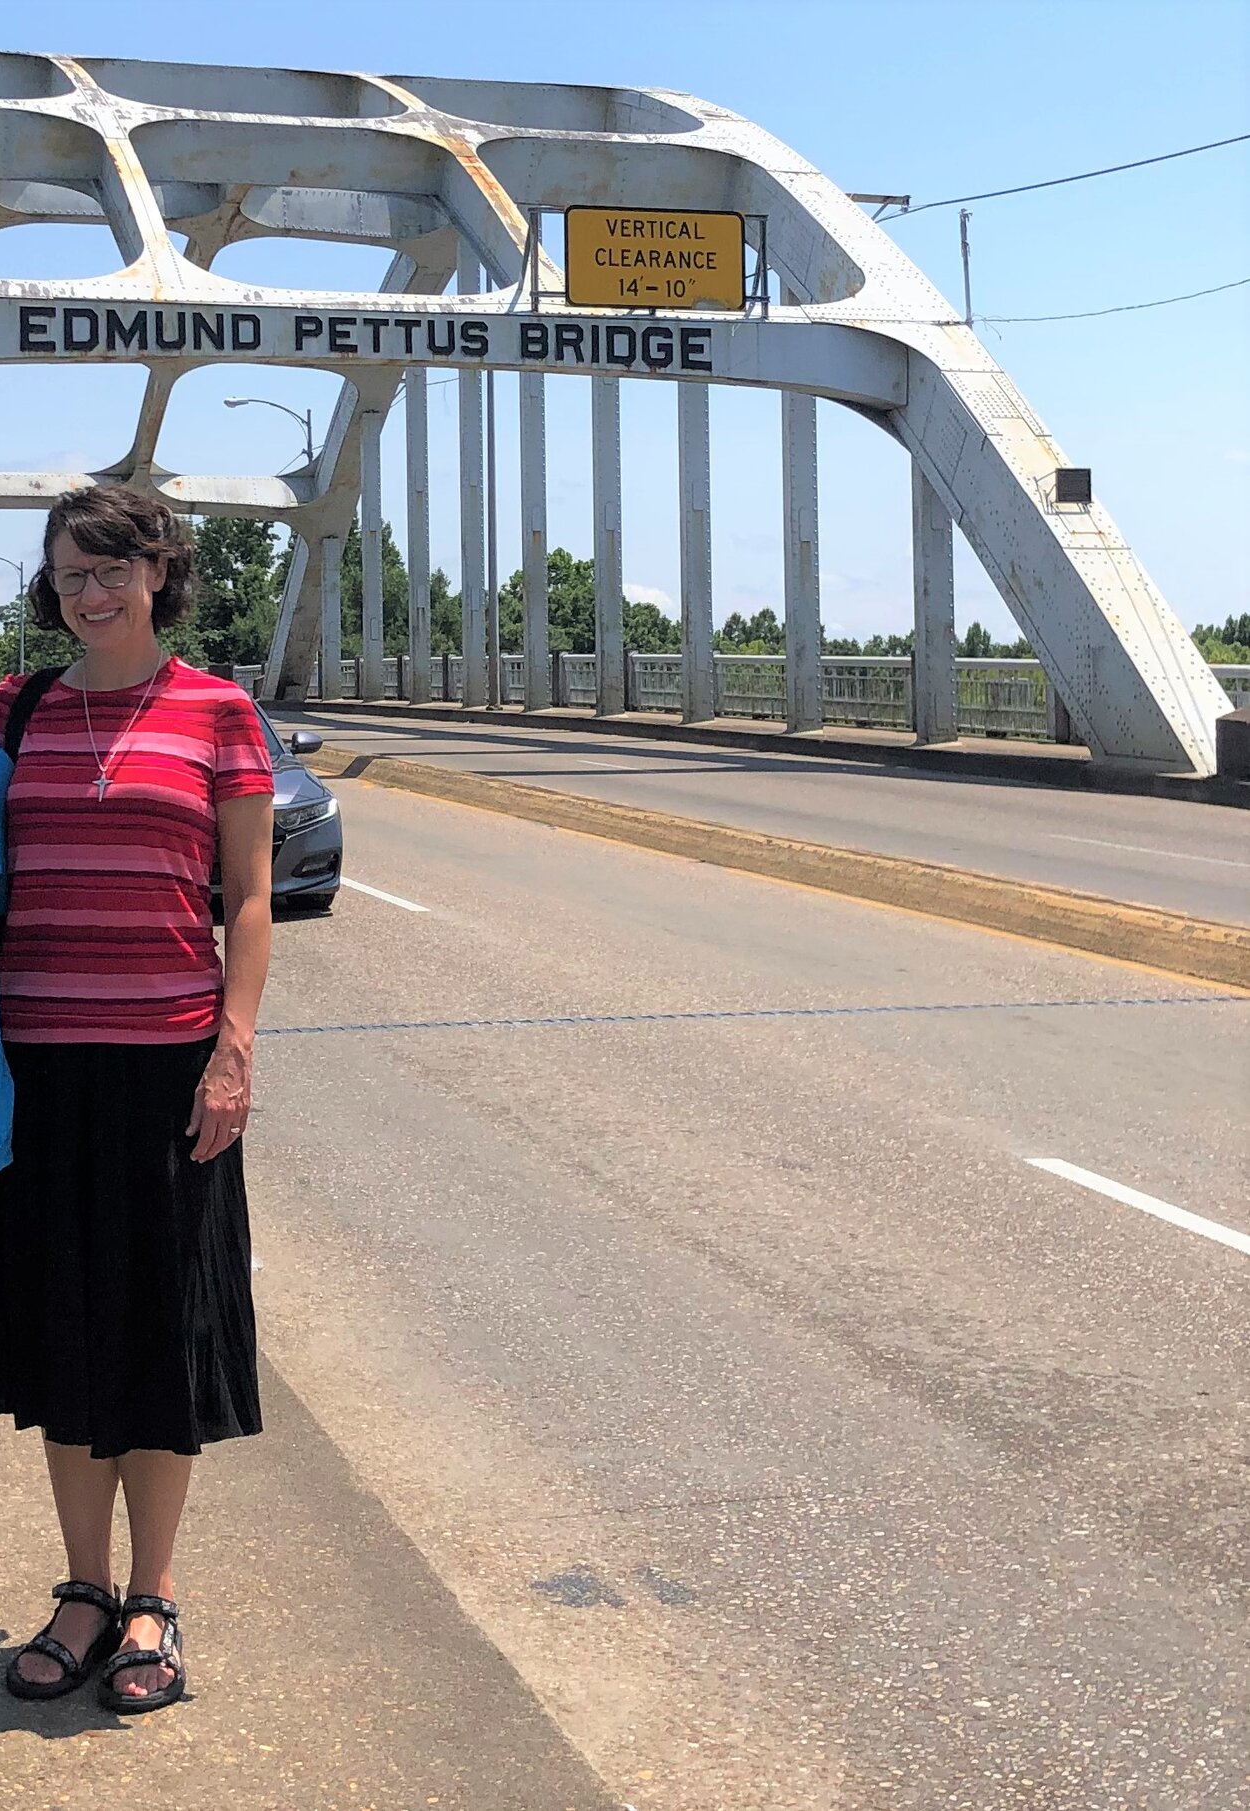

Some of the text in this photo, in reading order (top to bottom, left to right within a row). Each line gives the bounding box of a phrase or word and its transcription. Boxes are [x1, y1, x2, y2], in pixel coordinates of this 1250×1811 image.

[606, 218, 706, 240] VERTICAL
[595, 248, 718, 270] CLEARANCE
[19, 306, 712, 373] EDMUND PETTUS BRIDGE
